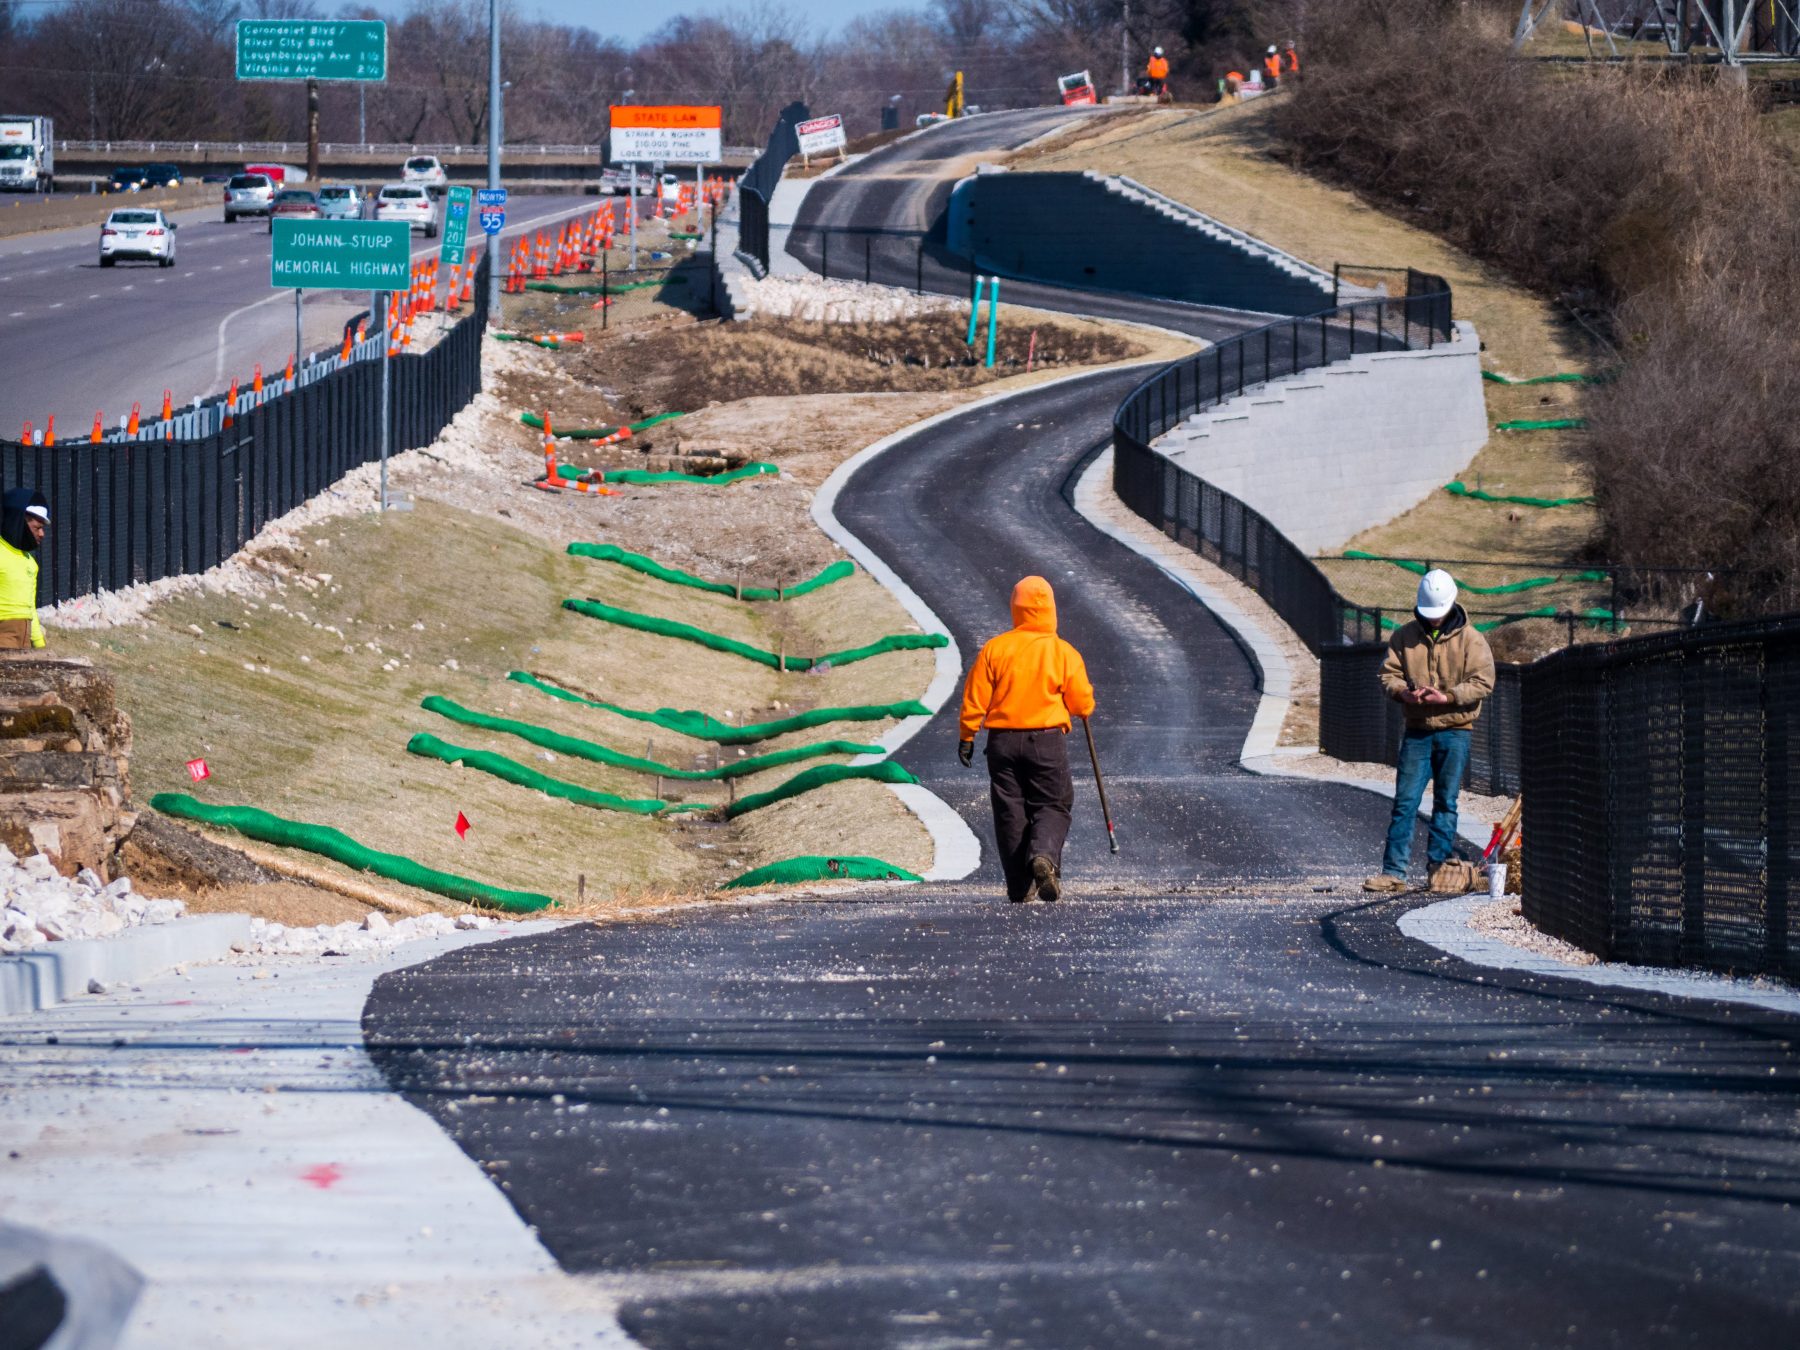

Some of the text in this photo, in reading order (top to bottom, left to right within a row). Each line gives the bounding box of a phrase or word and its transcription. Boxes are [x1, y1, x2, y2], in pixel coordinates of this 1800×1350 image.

[244, 25, 305, 35] Carondelet
[311, 26, 335, 35] Blvd
[244, 38, 334, 49] River City Blvd
[243, 51, 324, 62] Loughborough
[329, 51, 351, 60] Ave
[244, 63, 290, 74] Virginia
[295, 64, 317, 73] Ave
[634, 113, 697, 122] STATE LAW
[620, 150, 642, 158] LOSE
[648, 150, 671, 158] YOUR
[479, 192, 505, 202] NORTH
[448, 220, 464, 231] MILE
[482, 213, 502, 229] 55
[290, 233, 393, 248] JOHANN STUPP
[446, 231, 463, 244] 201
[450, 250, 459, 263] 2
[275, 260, 406, 276] MEMORIAL HIGHWAY
